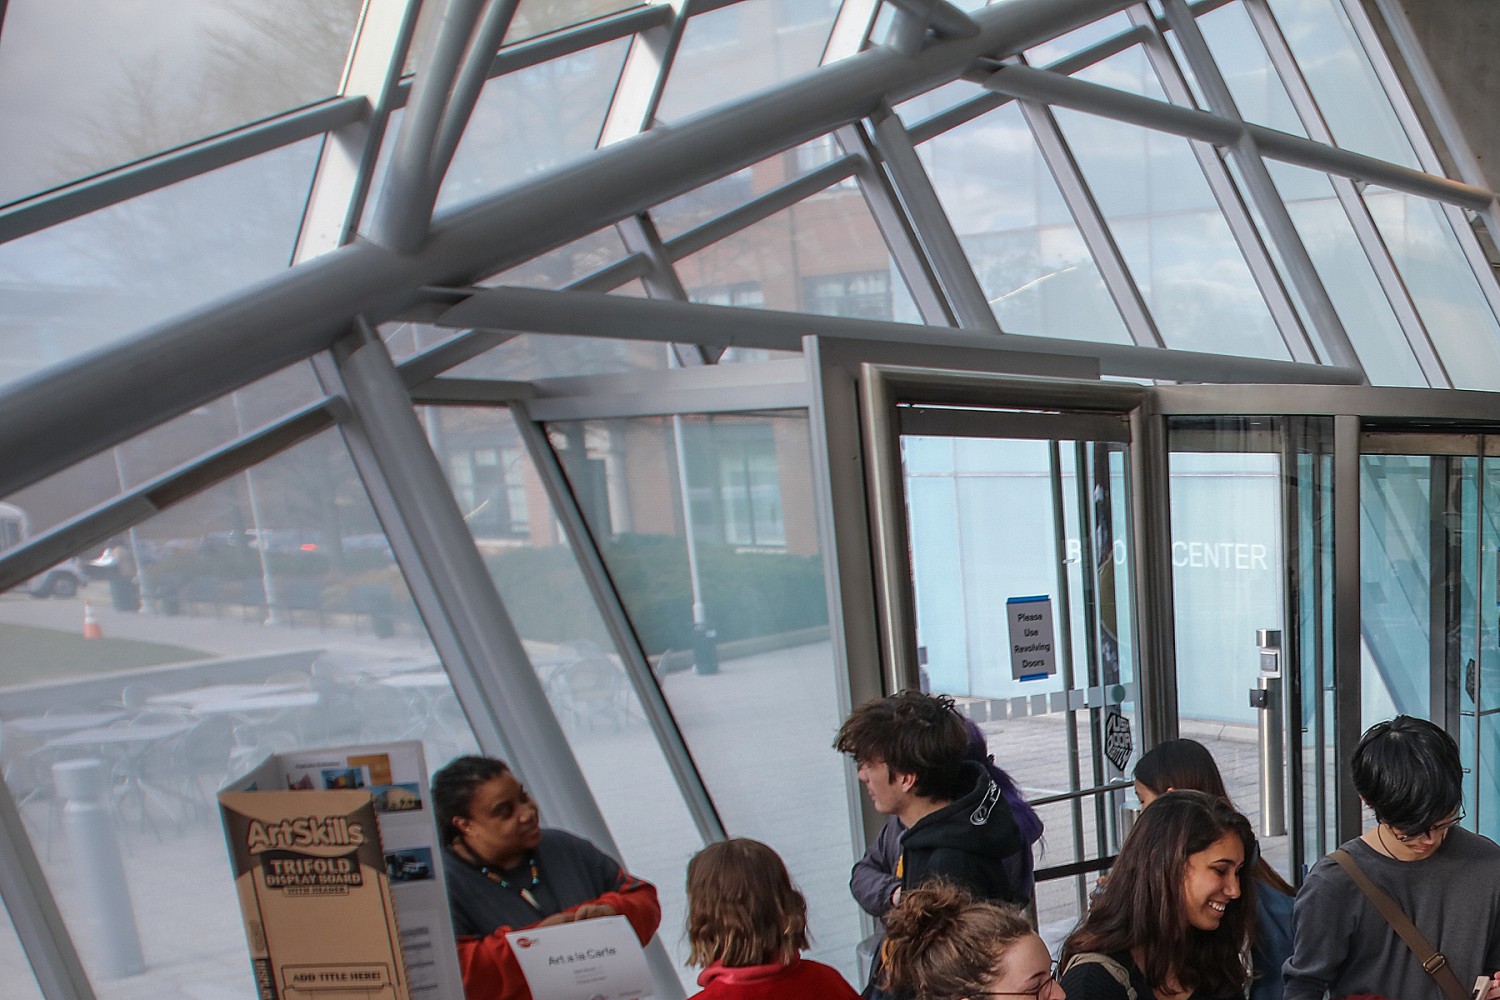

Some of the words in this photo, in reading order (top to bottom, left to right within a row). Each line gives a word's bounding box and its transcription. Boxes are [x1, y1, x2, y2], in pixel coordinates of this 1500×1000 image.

[1172, 541, 1267, 570] CENTER
[1017, 613, 1043, 622] Please
[1023, 628, 1039, 637] Use
[1014, 643, 1051, 654] Revolving
[1022, 659, 1046, 668] Doors
[247, 815, 365, 848] ArtSkills
[270, 858, 351, 875] TRIFOLD
[266, 875, 316, 886] DISPLAY
[319, 873, 361, 885] BOARD
[287, 887, 310, 895] WITH
[548, 954, 566, 966] Art
[586, 946, 617, 960] Carte
[293, 972, 316, 981] ADD
[319, 973, 347, 981] TITLE
[350, 972, 381, 980] HERE!
